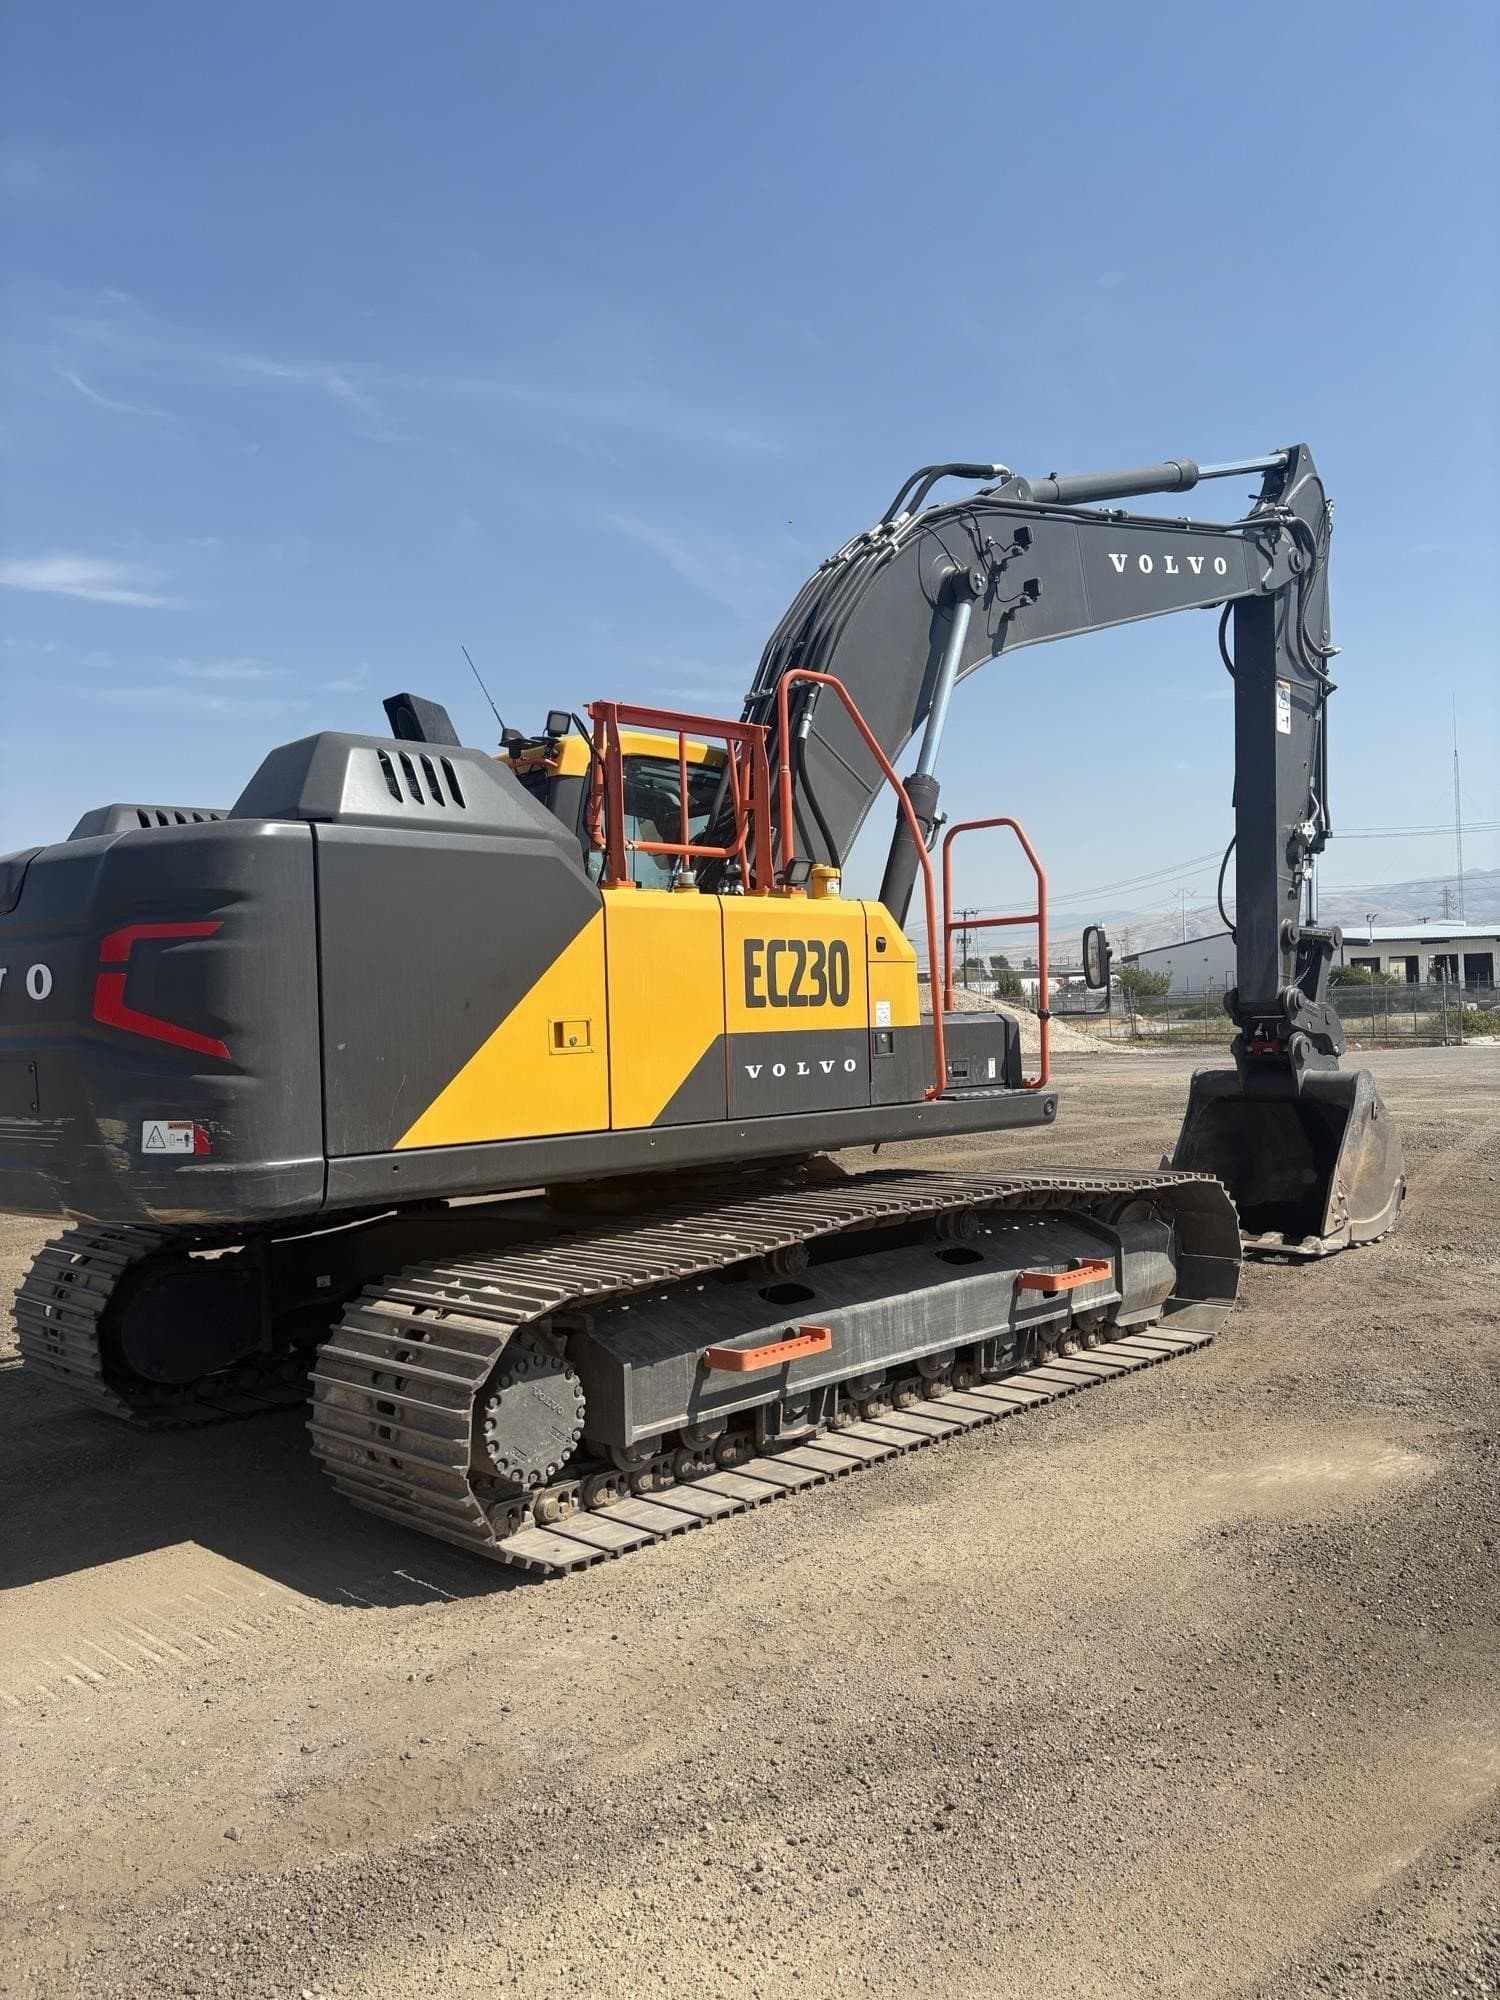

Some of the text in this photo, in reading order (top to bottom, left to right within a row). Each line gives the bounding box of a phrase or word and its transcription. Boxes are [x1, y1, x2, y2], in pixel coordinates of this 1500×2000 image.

[1108, 553, 1227, 575] VOLVO
[744, 939, 850, 1008] EC230
[745, 1059, 857, 1079] VOLVO
[532, 1386, 565, 1416] VOLVO
